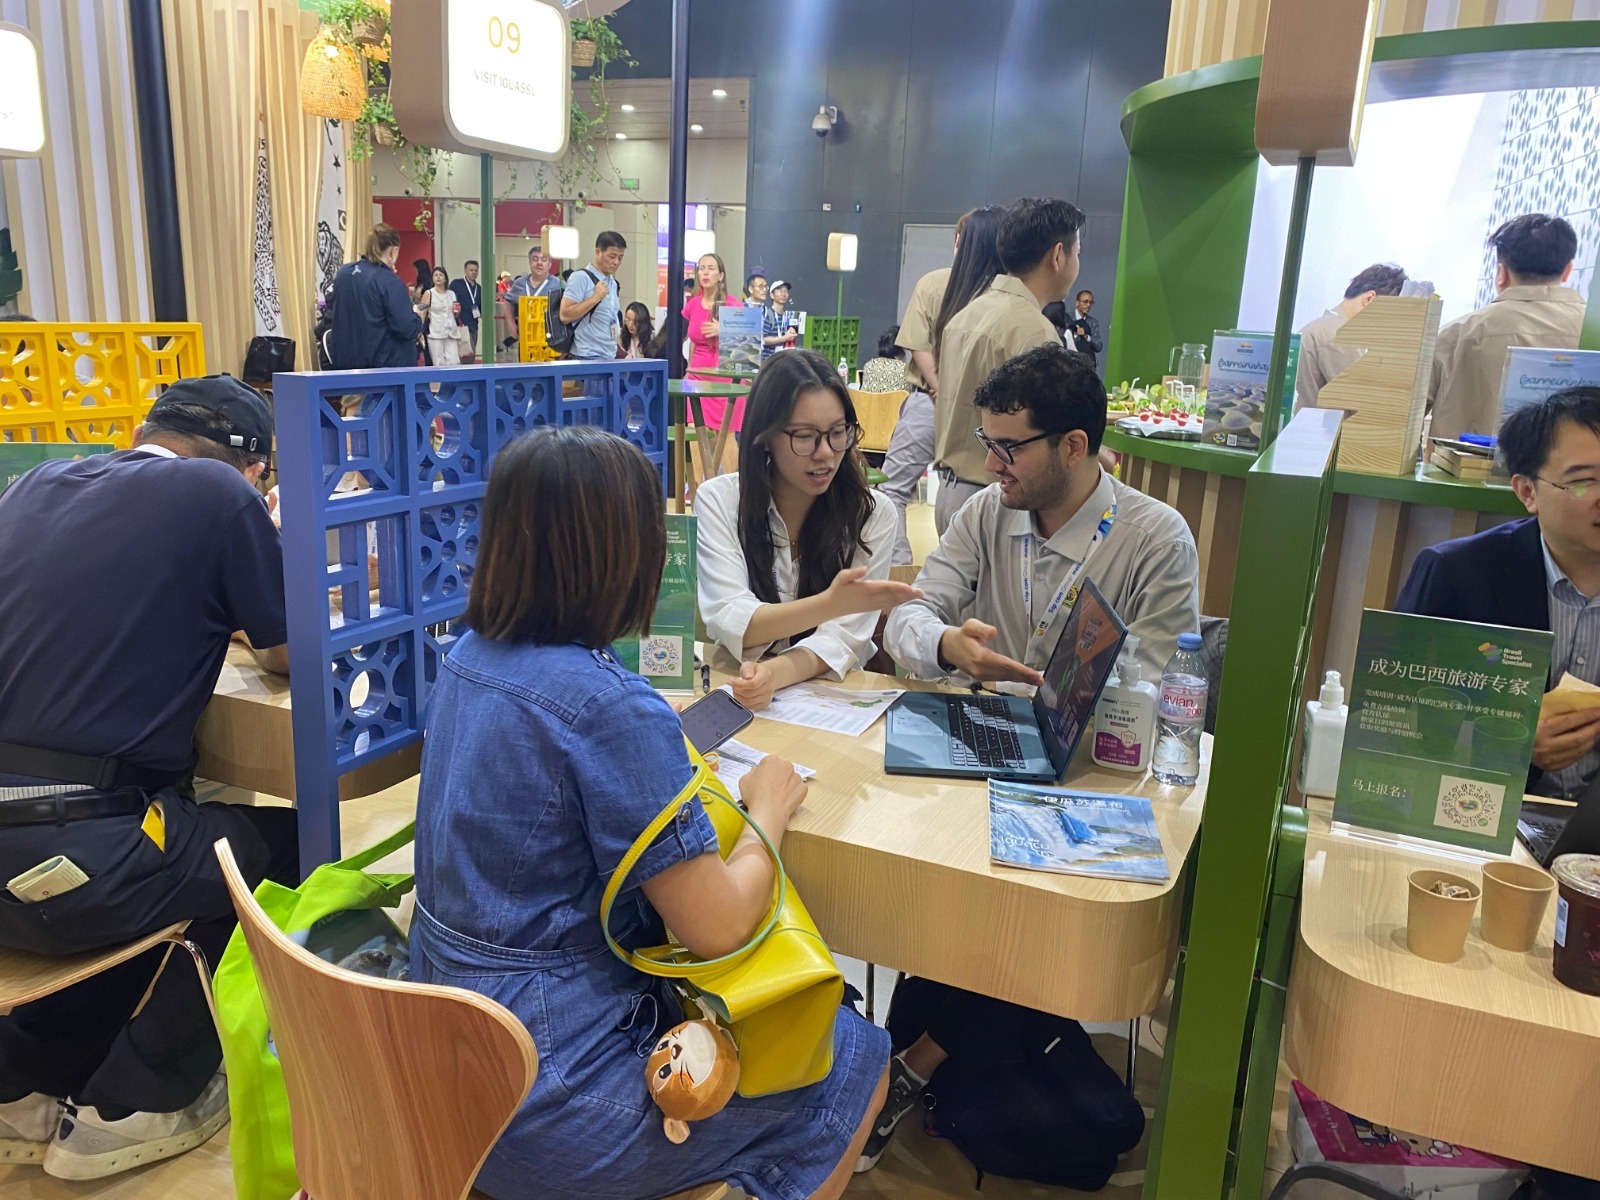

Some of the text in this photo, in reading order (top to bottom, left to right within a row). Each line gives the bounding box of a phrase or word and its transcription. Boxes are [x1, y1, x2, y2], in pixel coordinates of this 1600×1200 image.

[488, 15, 521, 54] 09
[1048, 591, 1064, 614] Trip.com
[1502, 653, 1523, 661] Travel
[1503, 647, 1523, 656] Brasil
[1501, 659, 1533, 669] Specialist
[1368, 658, 1530, 696] 成为巴西旅游专家
[1163, 694, 1194, 708] evian
